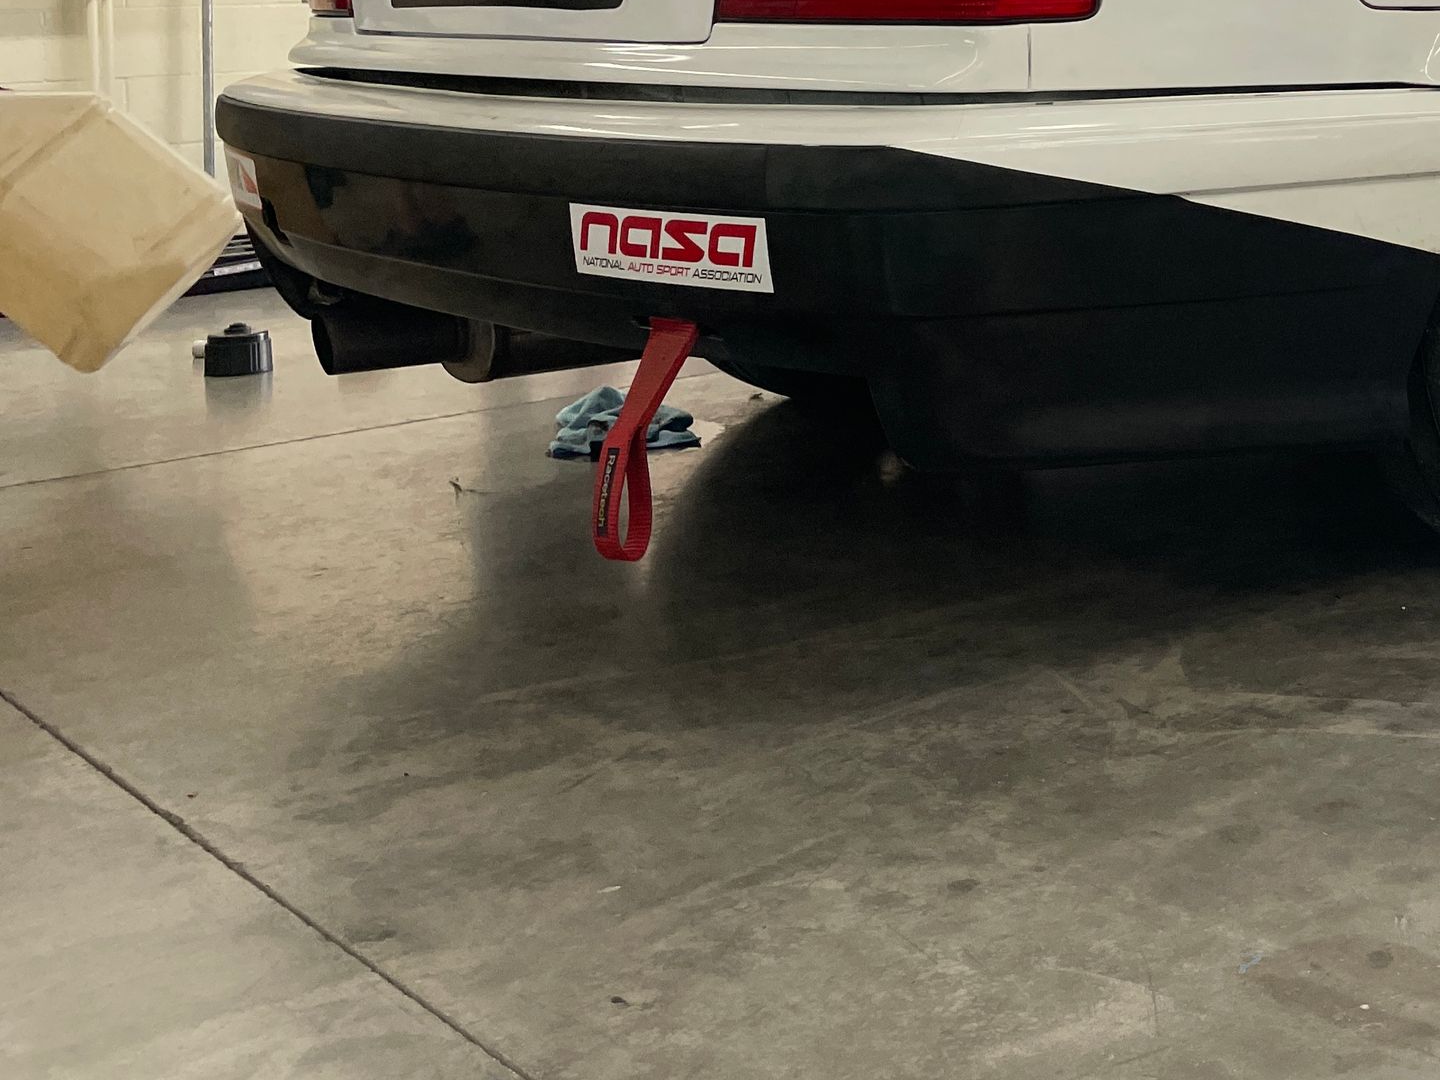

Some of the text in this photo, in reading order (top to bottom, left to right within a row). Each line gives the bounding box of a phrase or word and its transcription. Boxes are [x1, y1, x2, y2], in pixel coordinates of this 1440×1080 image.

[582, 256, 763, 284] NATIONAL AUTO SPORT ASSOCIATION
